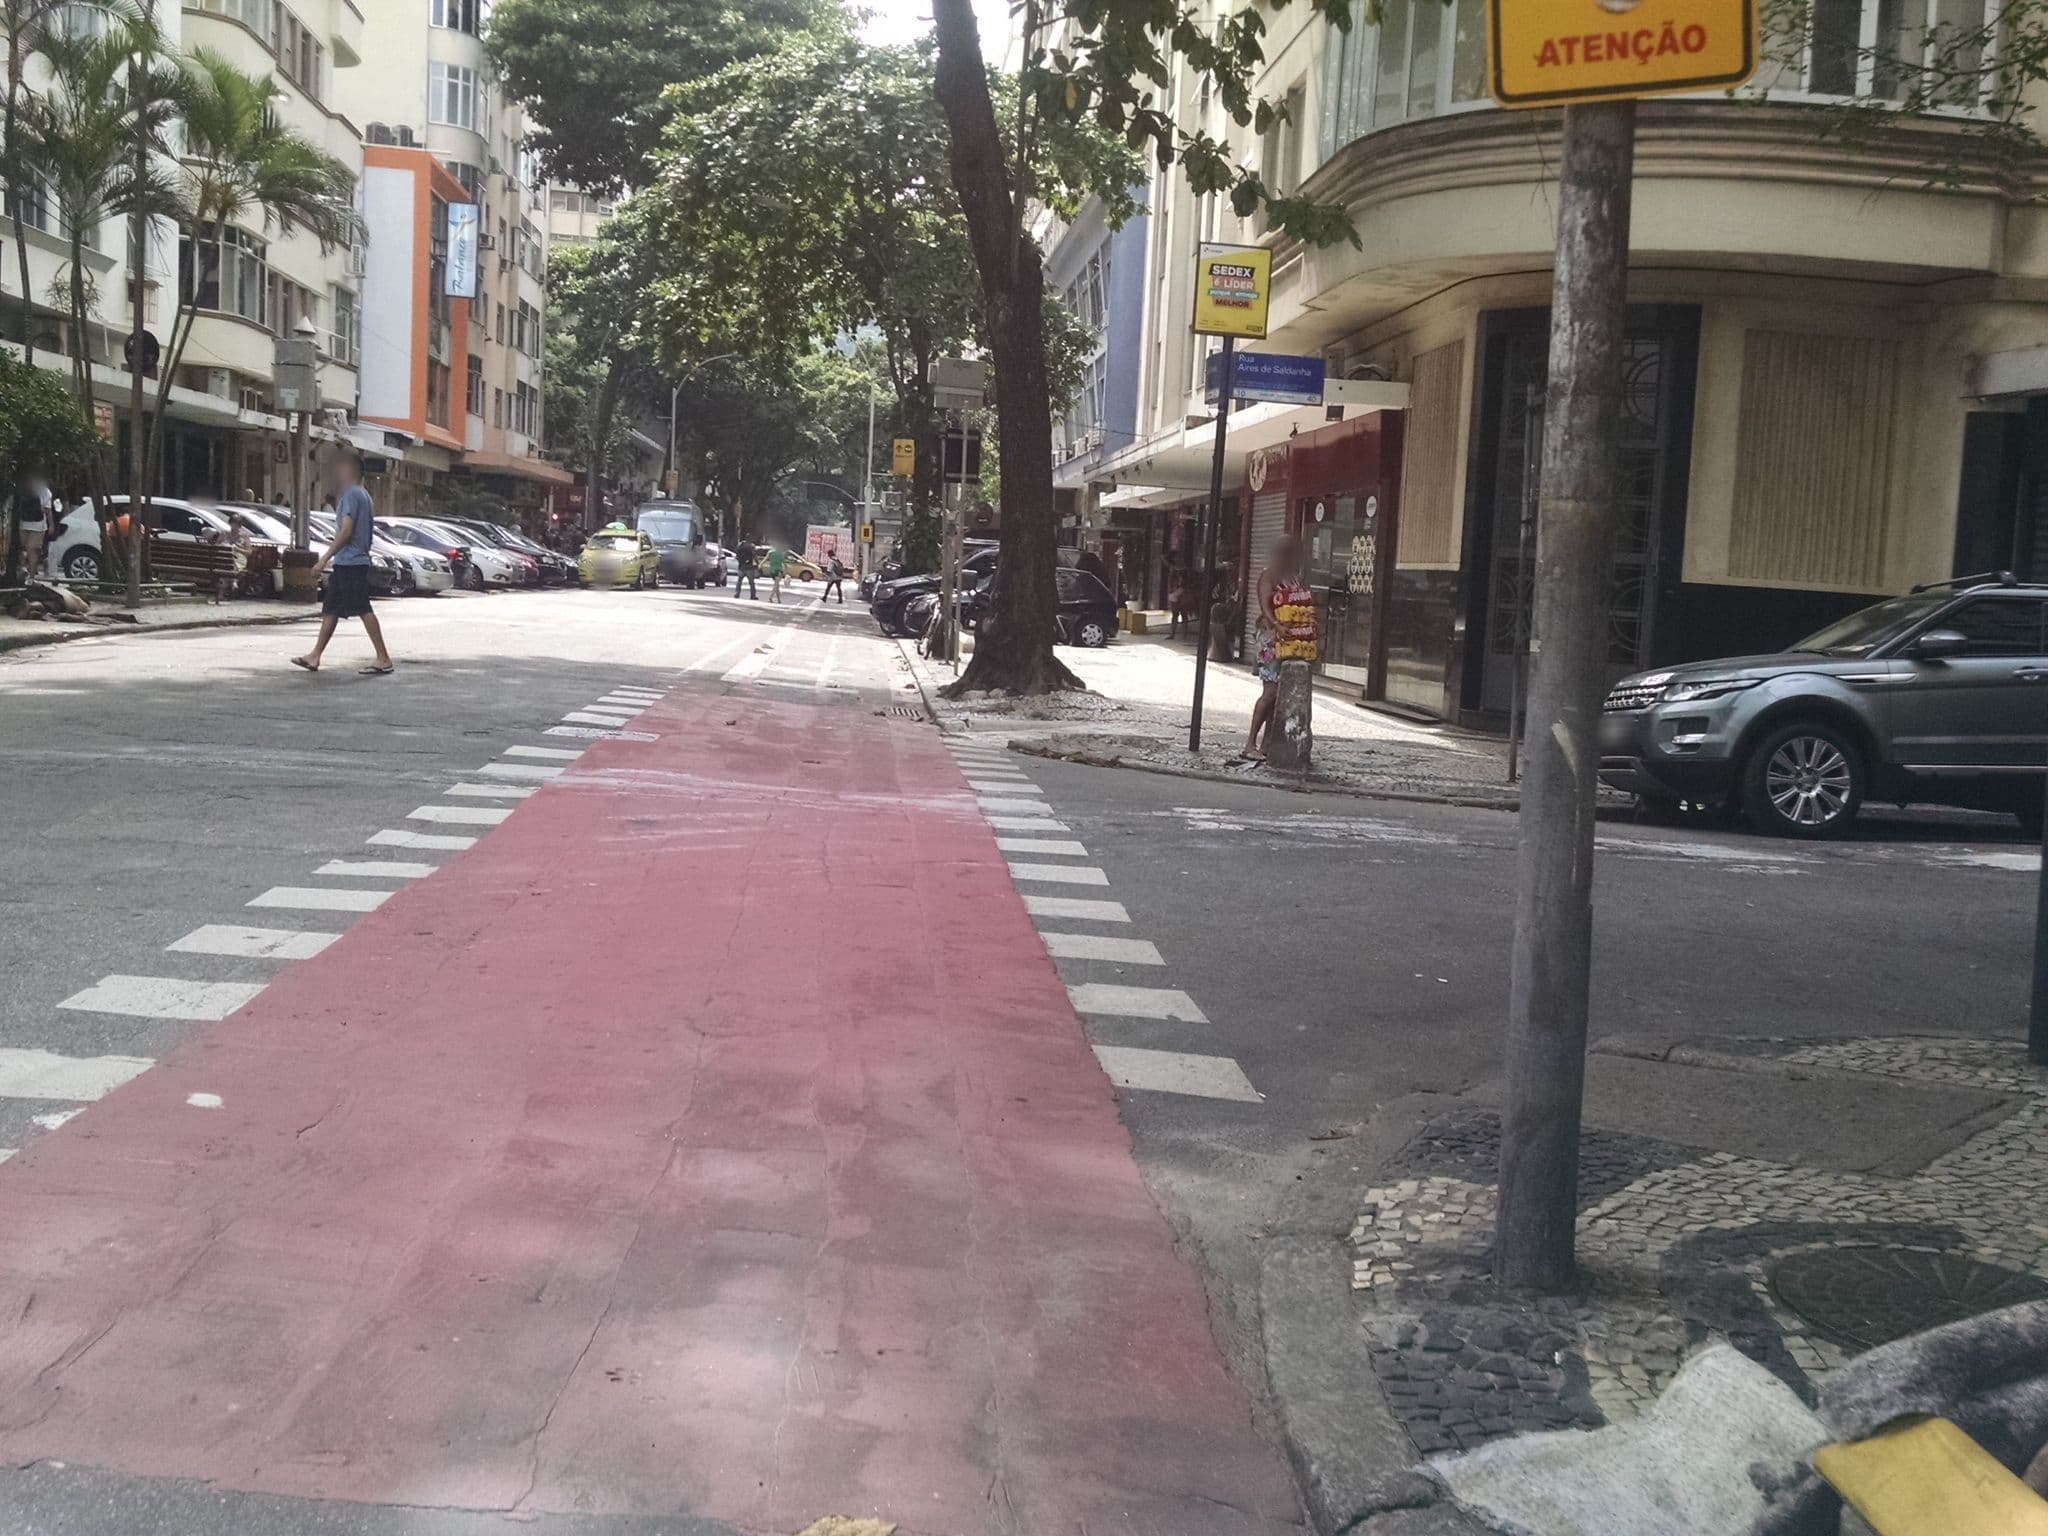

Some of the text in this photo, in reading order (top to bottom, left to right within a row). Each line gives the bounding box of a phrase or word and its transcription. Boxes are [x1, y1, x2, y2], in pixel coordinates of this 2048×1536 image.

[1536, 20, 1706, 66] ATENÇÃO
[1212, 265, 1251, 277] SEDEX
[1224, 278, 1254, 290] LÍDER
[1215, 299, 1249, 308] MELHOR
[1238, 354, 1254, 362] Rua
[1237, 363, 1312, 377] Aires de Saldanha
